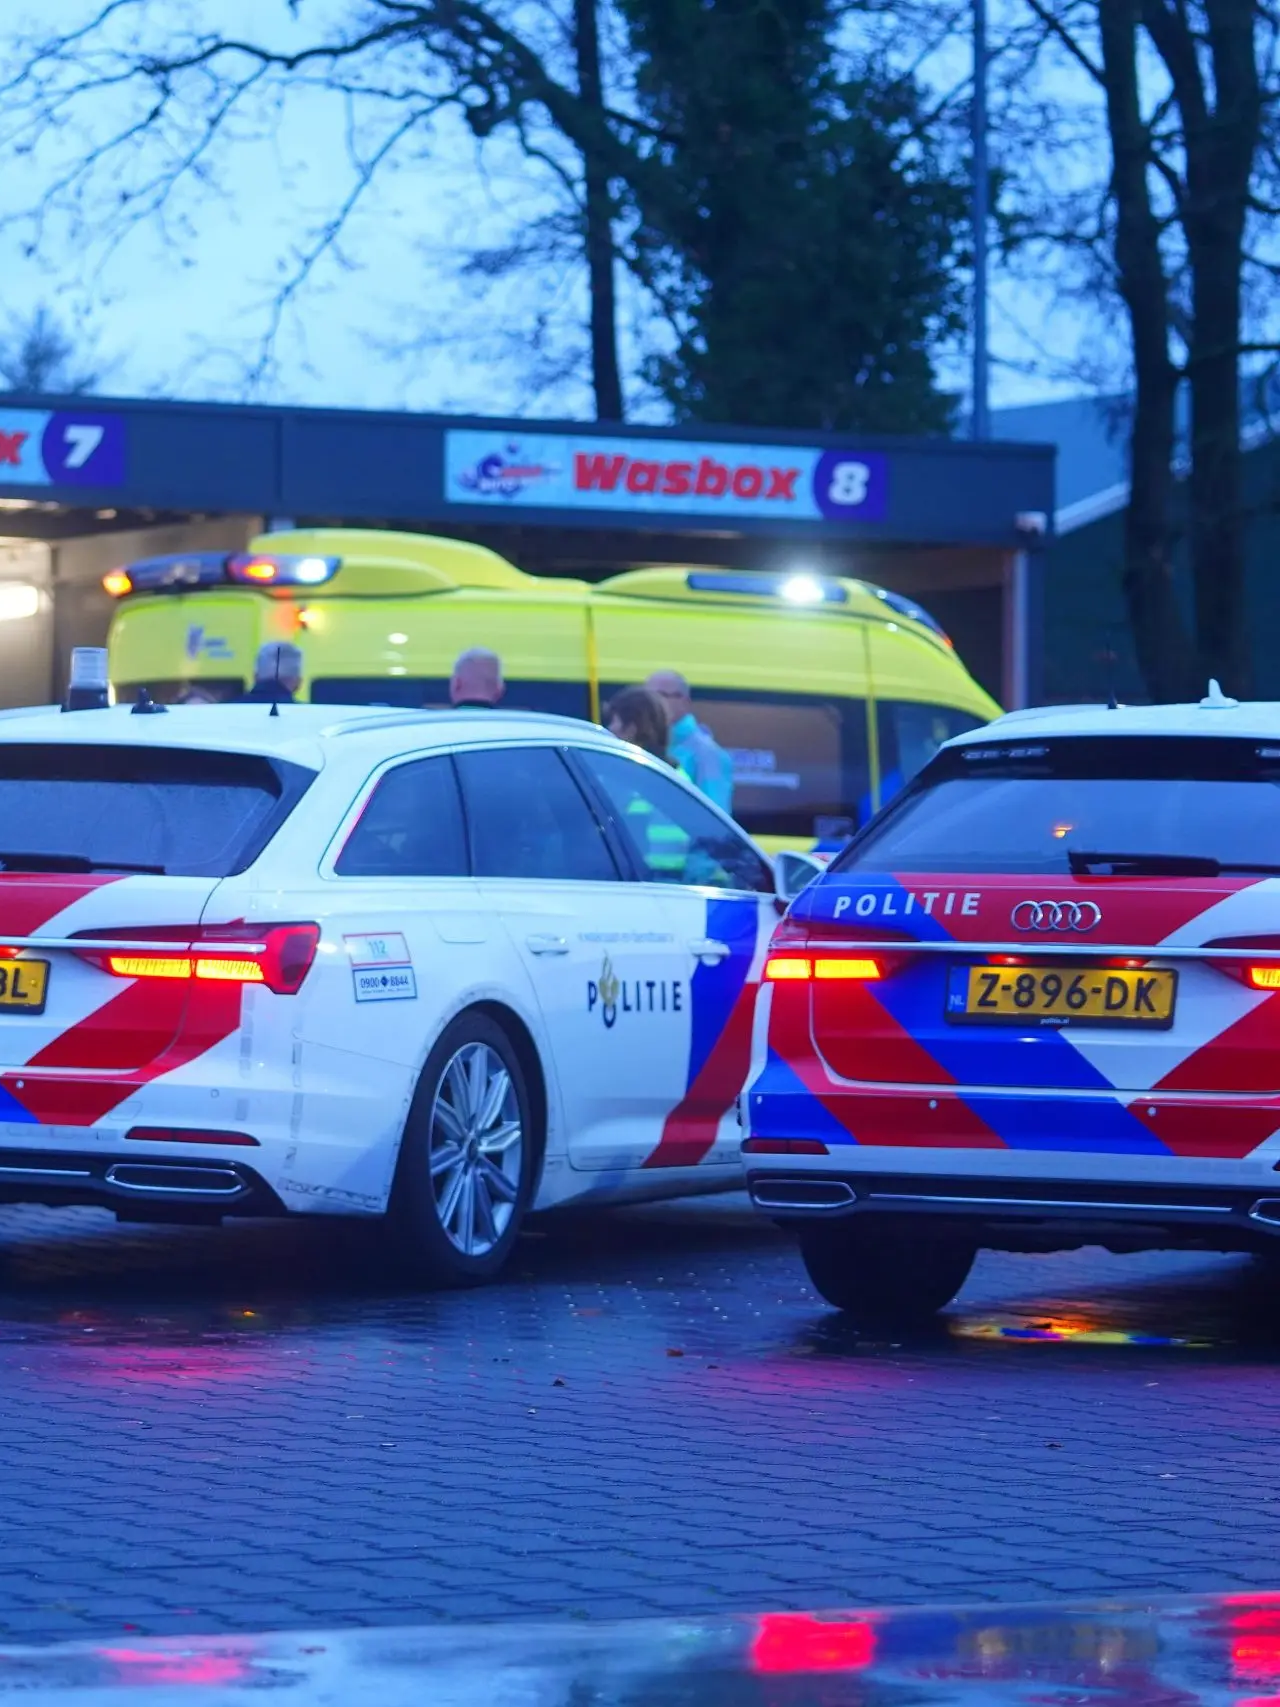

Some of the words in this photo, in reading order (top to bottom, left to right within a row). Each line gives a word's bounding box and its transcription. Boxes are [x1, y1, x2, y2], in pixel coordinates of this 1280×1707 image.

[63, 425, 105, 469] 7
[574, 453, 800, 500] Wasbox
[828, 461, 871, 505] 8
[833, 892, 981, 919] POLITIE
[977, 973, 1157, 1012] Z-896-DK
